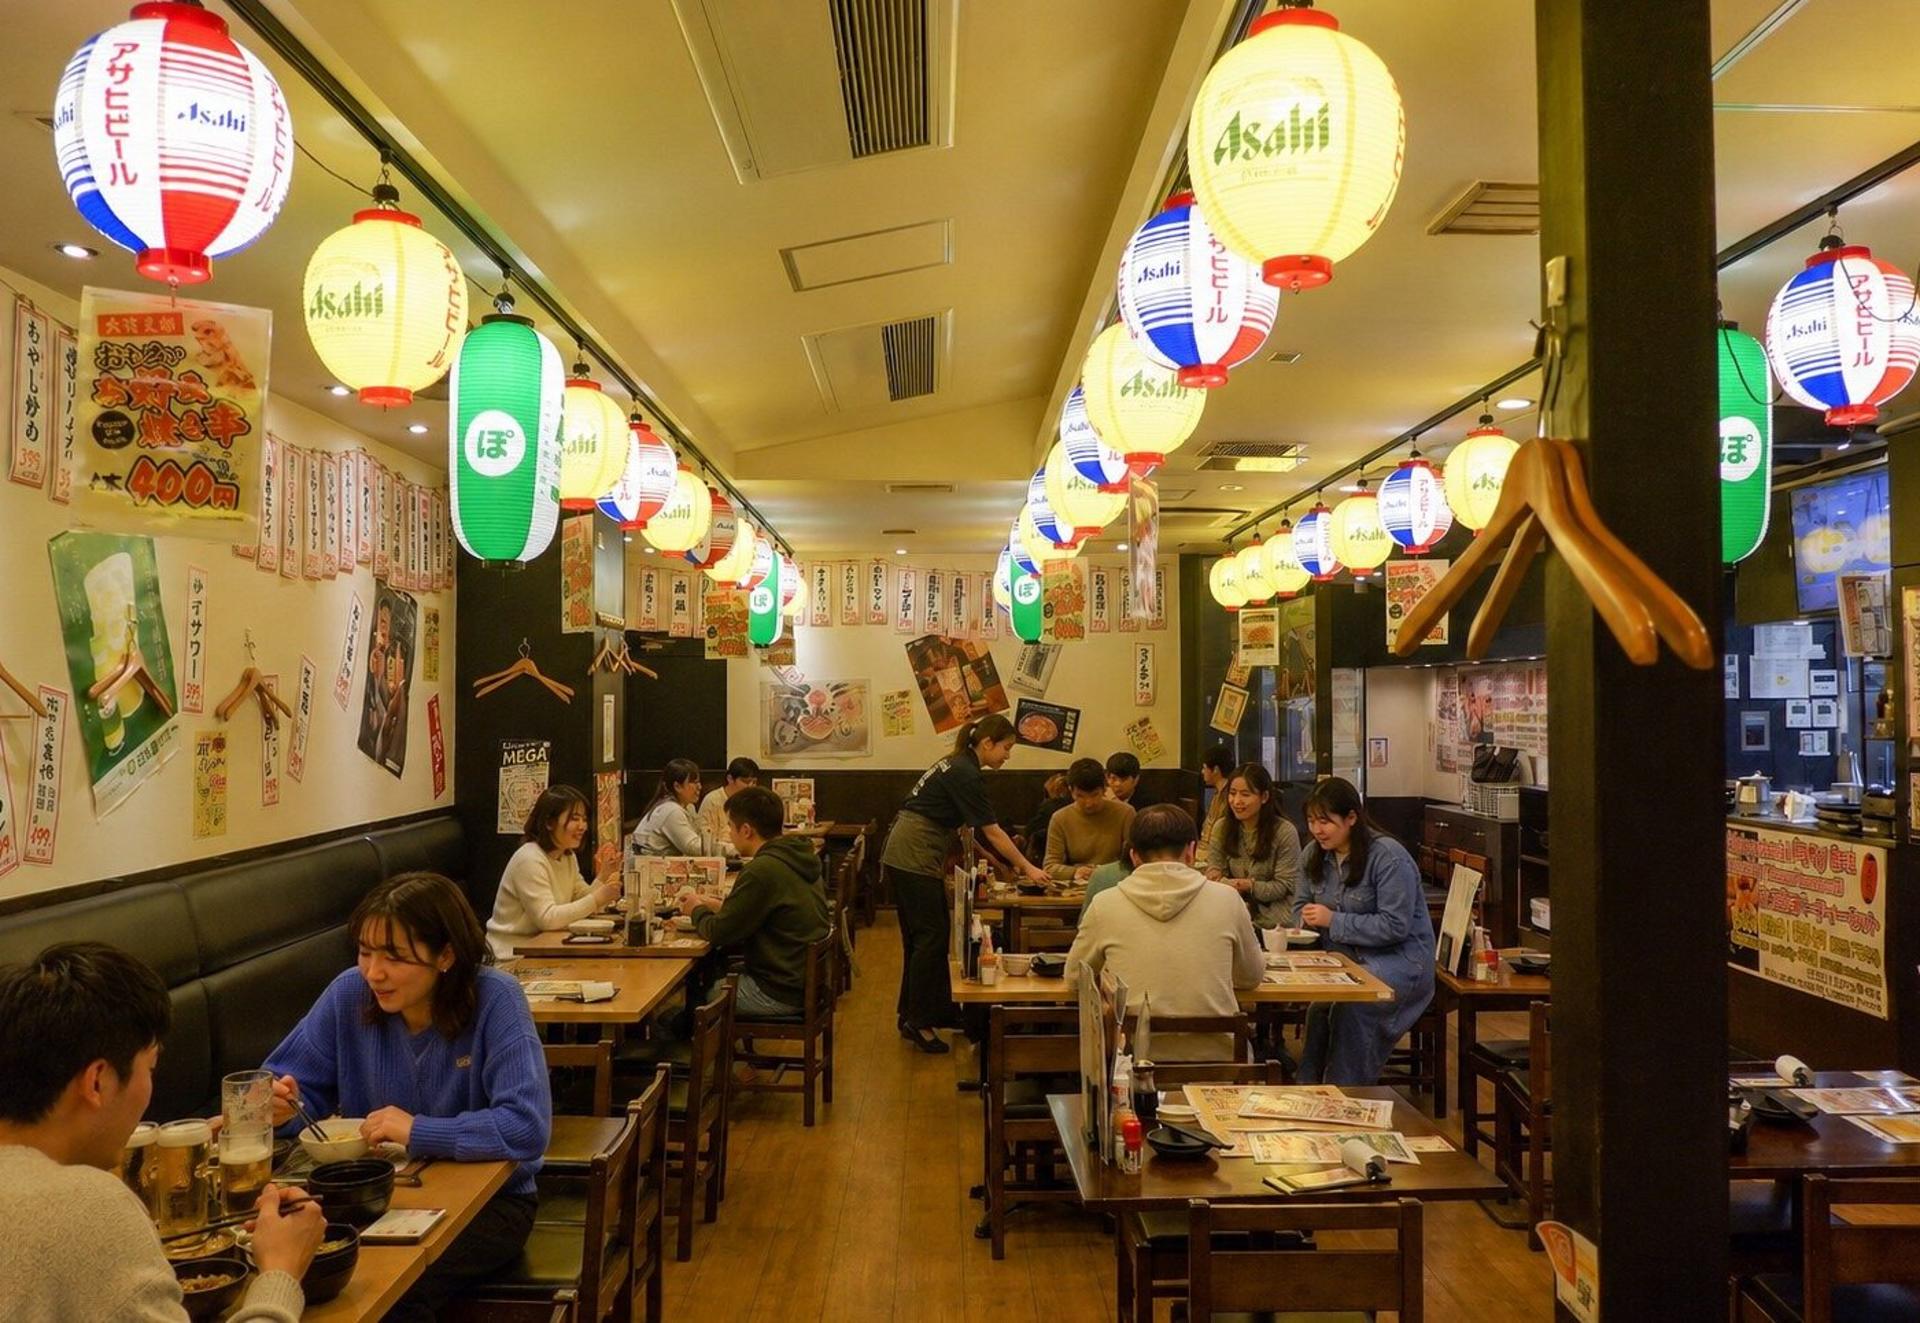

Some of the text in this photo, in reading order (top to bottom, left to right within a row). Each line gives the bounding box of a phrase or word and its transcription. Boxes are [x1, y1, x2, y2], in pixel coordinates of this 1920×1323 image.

[105, 42, 140, 186] アサヒビール
[177, 102, 246, 133] Asahi
[1213, 102, 1329, 166] Asahi
[1137, 260, 1181, 284] Asahi
[1206, 230, 1229, 323] サヒビール
[309, 280, 384, 320] Asahi
[1786, 317, 1828, 341] Asahi
[1850, 274, 1875, 368] アサヒビール
[477, 430, 515, 459] ぽ
[503, 747, 547, 766] MEGA
